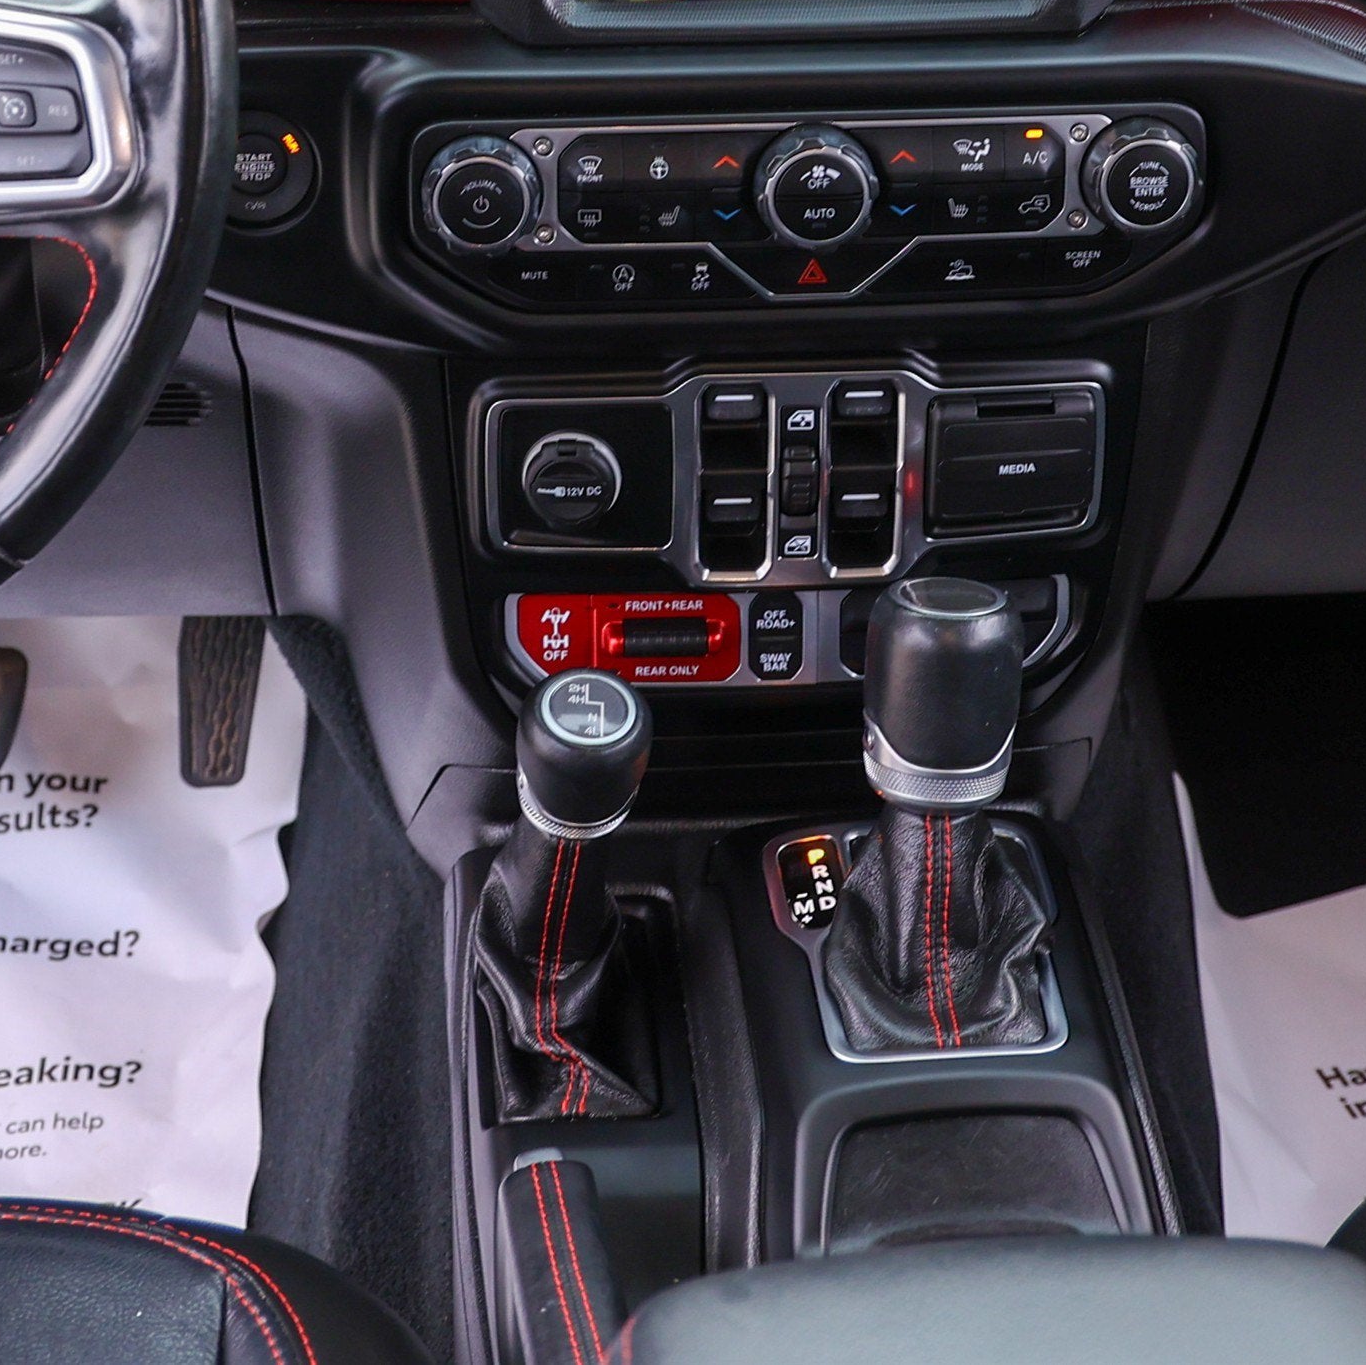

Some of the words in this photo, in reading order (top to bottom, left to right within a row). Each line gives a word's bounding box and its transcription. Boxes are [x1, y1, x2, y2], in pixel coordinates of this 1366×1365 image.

[235, 153, 272, 162] START
[1022, 150, 1050, 166] A/C
[234, 162, 275, 173] ENGINE
[960, 162, 985, 172] MODE
[240, 173, 272, 181] STOP
[576, 173, 604, 184] FRONT
[807, 176, 831, 190] OFF
[1130, 177, 1169, 186] BROWSE
[465, 179, 497, 191] VOLUME
[1134, 187, 1165, 197] ENTER
[803, 207, 835, 220] AUTO
[1065, 249, 1101, 262] SCREEN
[1072, 257, 1093, 269] OFF
[521, 270, 549, 281] MUTE
[614, 281, 634, 293] OFF
[691, 281, 711, 292] OFF
[998, 462, 1036, 476] MEDIA
[566, 486, 584, 497] 12V
[586, 485, 602, 496] DC
[763, 609, 787, 620] OFF
[542, 650, 568, 661] OFF
[759, 652, 793, 663] SWAY
[635, 665, 667, 677] REAR
[669, 665, 699, 676] ONLY
[763, 662, 788, 672] BAR
[568, 682, 586, 693] 2H
[567, 694, 586, 704] 4H
[23, 771, 110, 797] your
[807, 848, 825, 865] P
[811, 864, 830, 880] R
[815, 879, 834, 895] N
[793, 899, 816, 916] M
[818, 896, 837, 911] D
[4, 1117, 46, 1135] can
[51, 1111, 106, 1133] help
